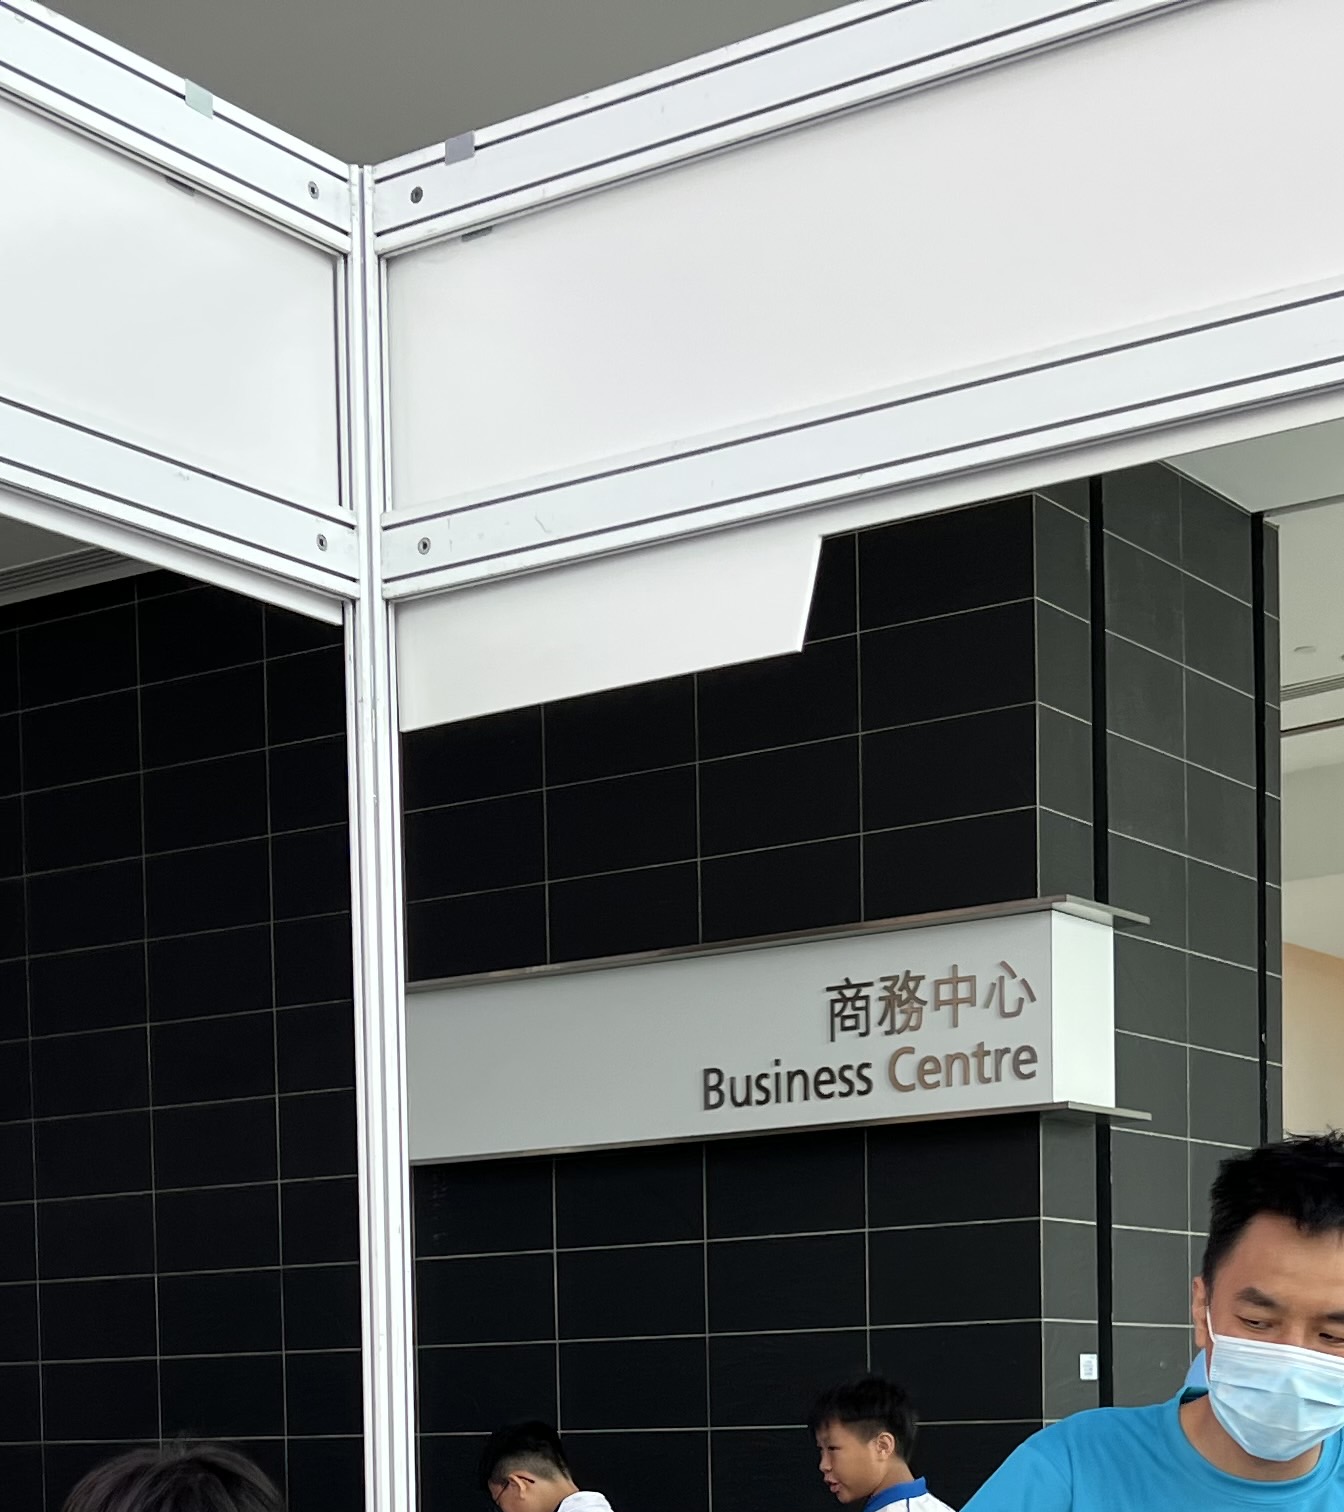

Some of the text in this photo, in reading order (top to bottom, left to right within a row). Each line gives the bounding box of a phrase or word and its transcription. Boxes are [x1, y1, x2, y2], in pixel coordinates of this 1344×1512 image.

[826, 961, 1037, 1043] 商務中心
[702, 1040, 1038, 1111] Business Centre
